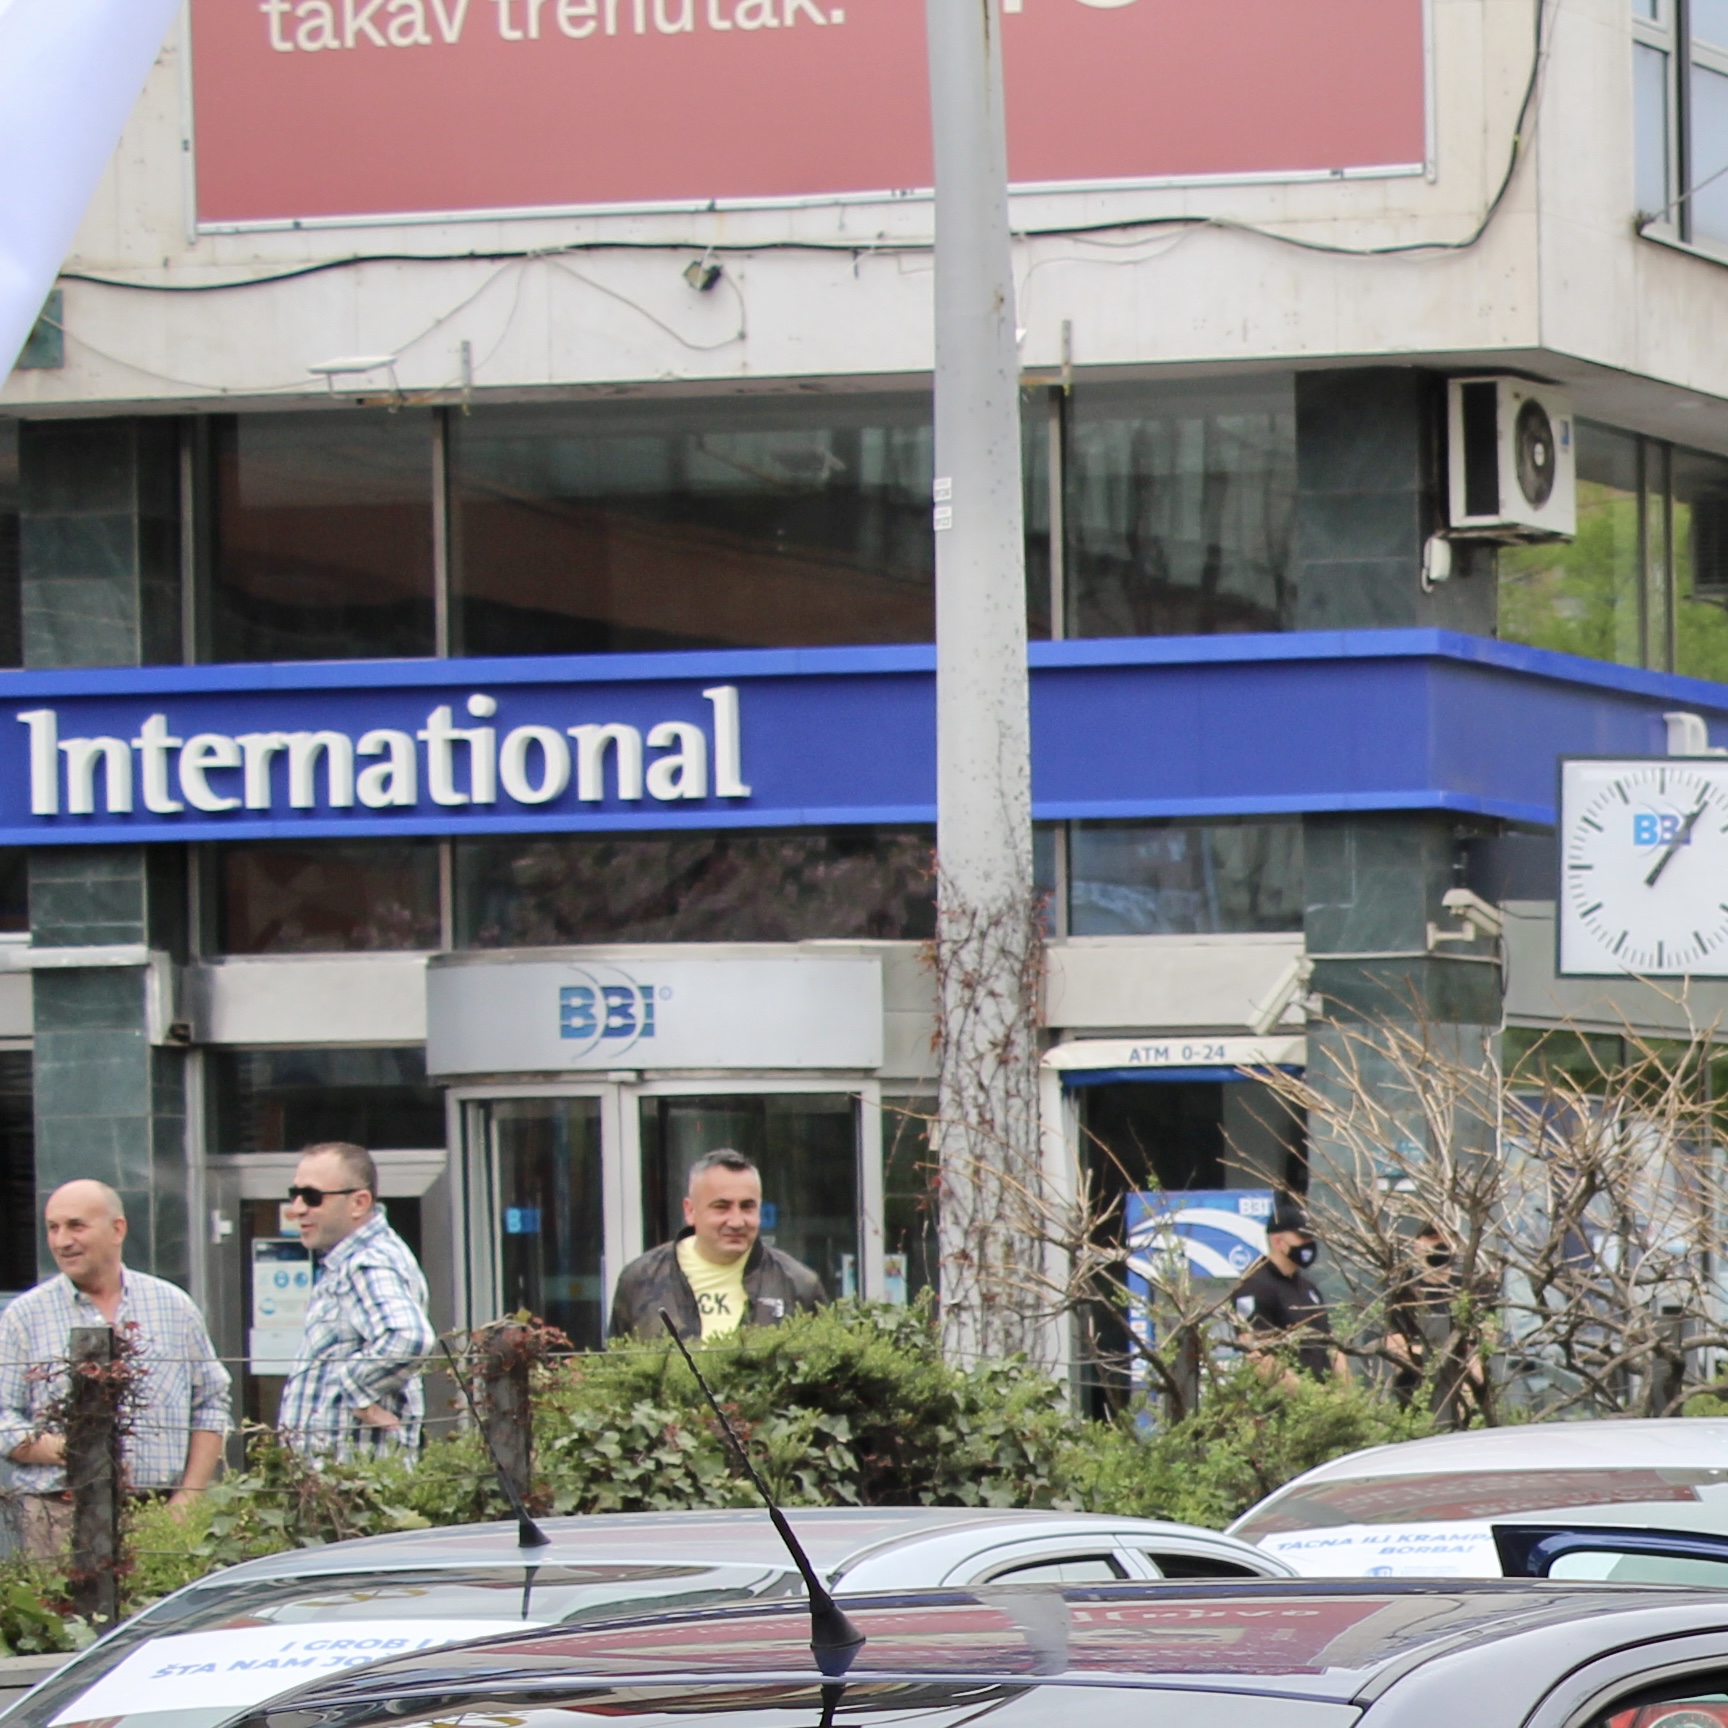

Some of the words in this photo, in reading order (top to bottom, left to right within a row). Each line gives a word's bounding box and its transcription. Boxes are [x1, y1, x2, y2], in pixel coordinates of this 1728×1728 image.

[17, 686, 751, 815] International
[560, 985, 655, 1040] BBI
[1129, 1048, 1169, 1062] ATM
[1181, 1045, 1226, 1061] 0-24
[1361, 1535, 1393, 1545] ILI
[303, 1637, 415, 1652] GROB
[150, 1662, 218, 1679] ŠTA
[226, 1655, 314, 1672] NAM
